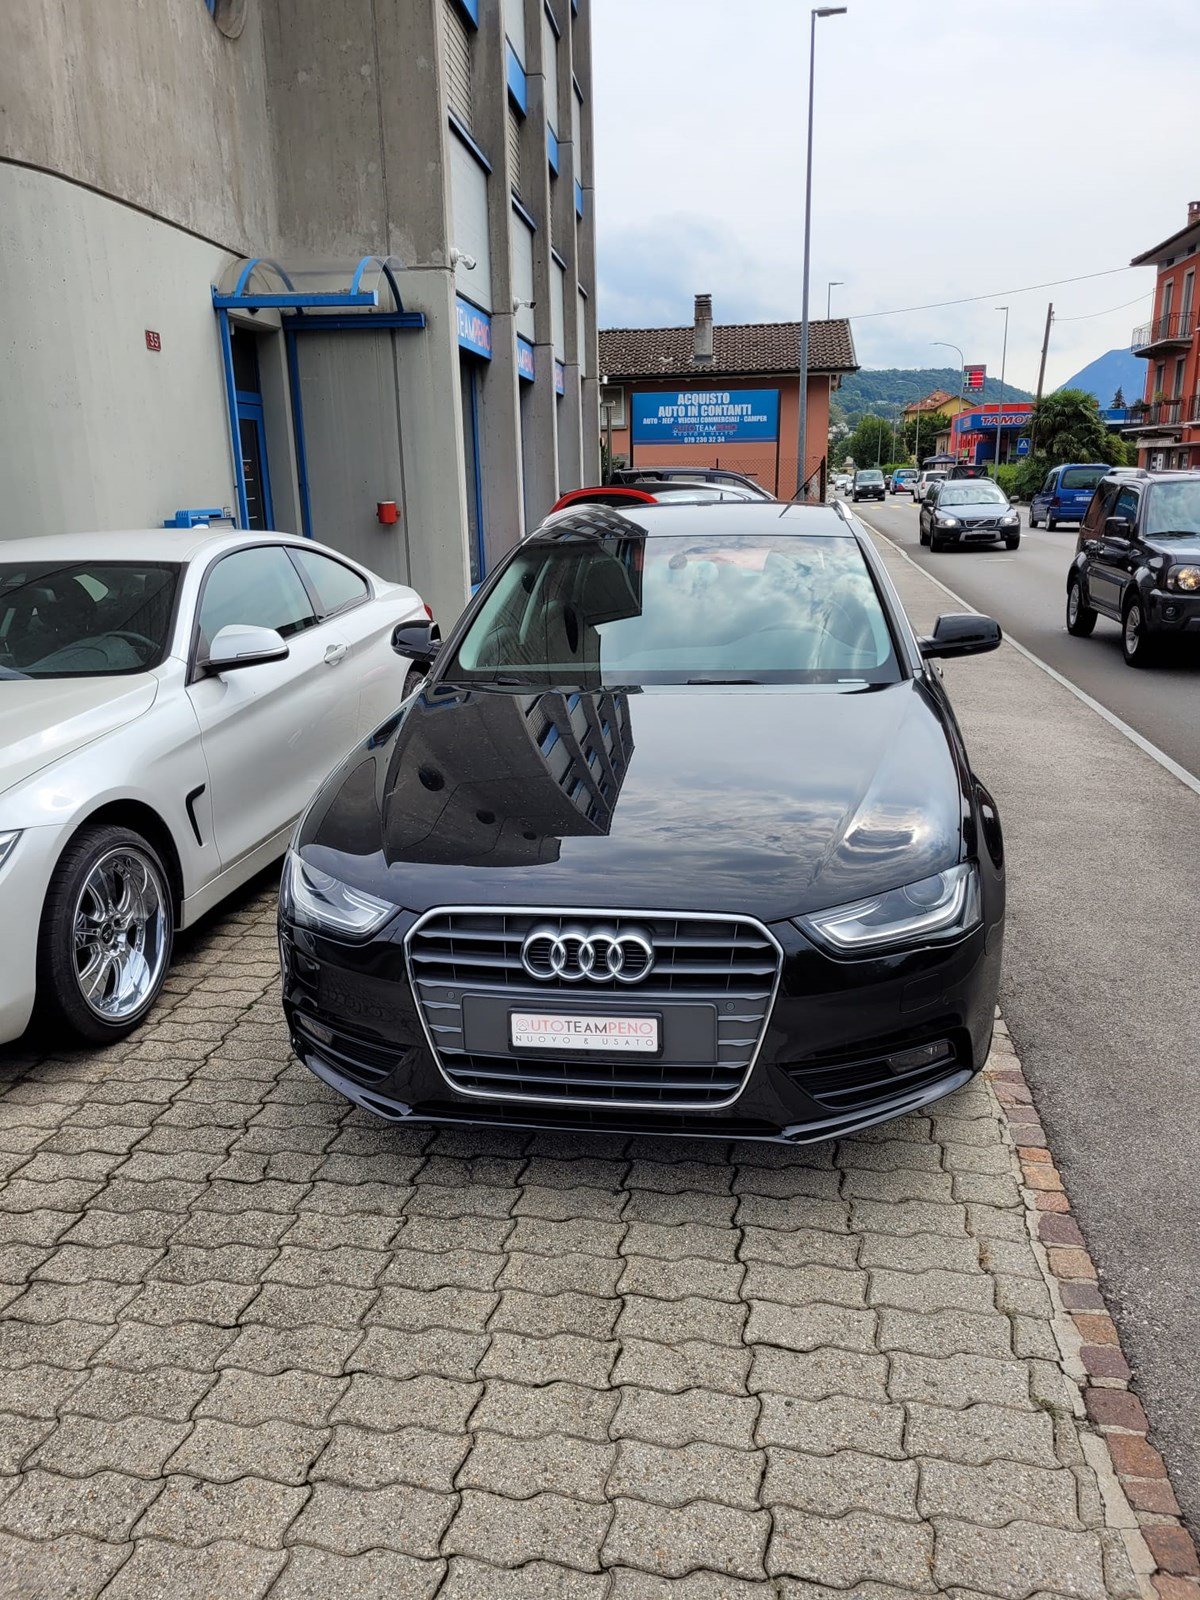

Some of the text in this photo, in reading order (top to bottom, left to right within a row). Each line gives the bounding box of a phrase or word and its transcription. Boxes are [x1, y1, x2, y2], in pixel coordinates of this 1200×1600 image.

[149, 333, 159, 347] 35
[677, 392, 730, 406] ACQUISTO
[658, 404, 752, 417] AUTO IN CONTANTI
[643, 417, 658, 425] AUTO
[678, 416, 699, 424] VEICOLI
[981, 415, 1033, 426] TAMO
[515, 1035, 654, 1047] NUOVO & USATO
